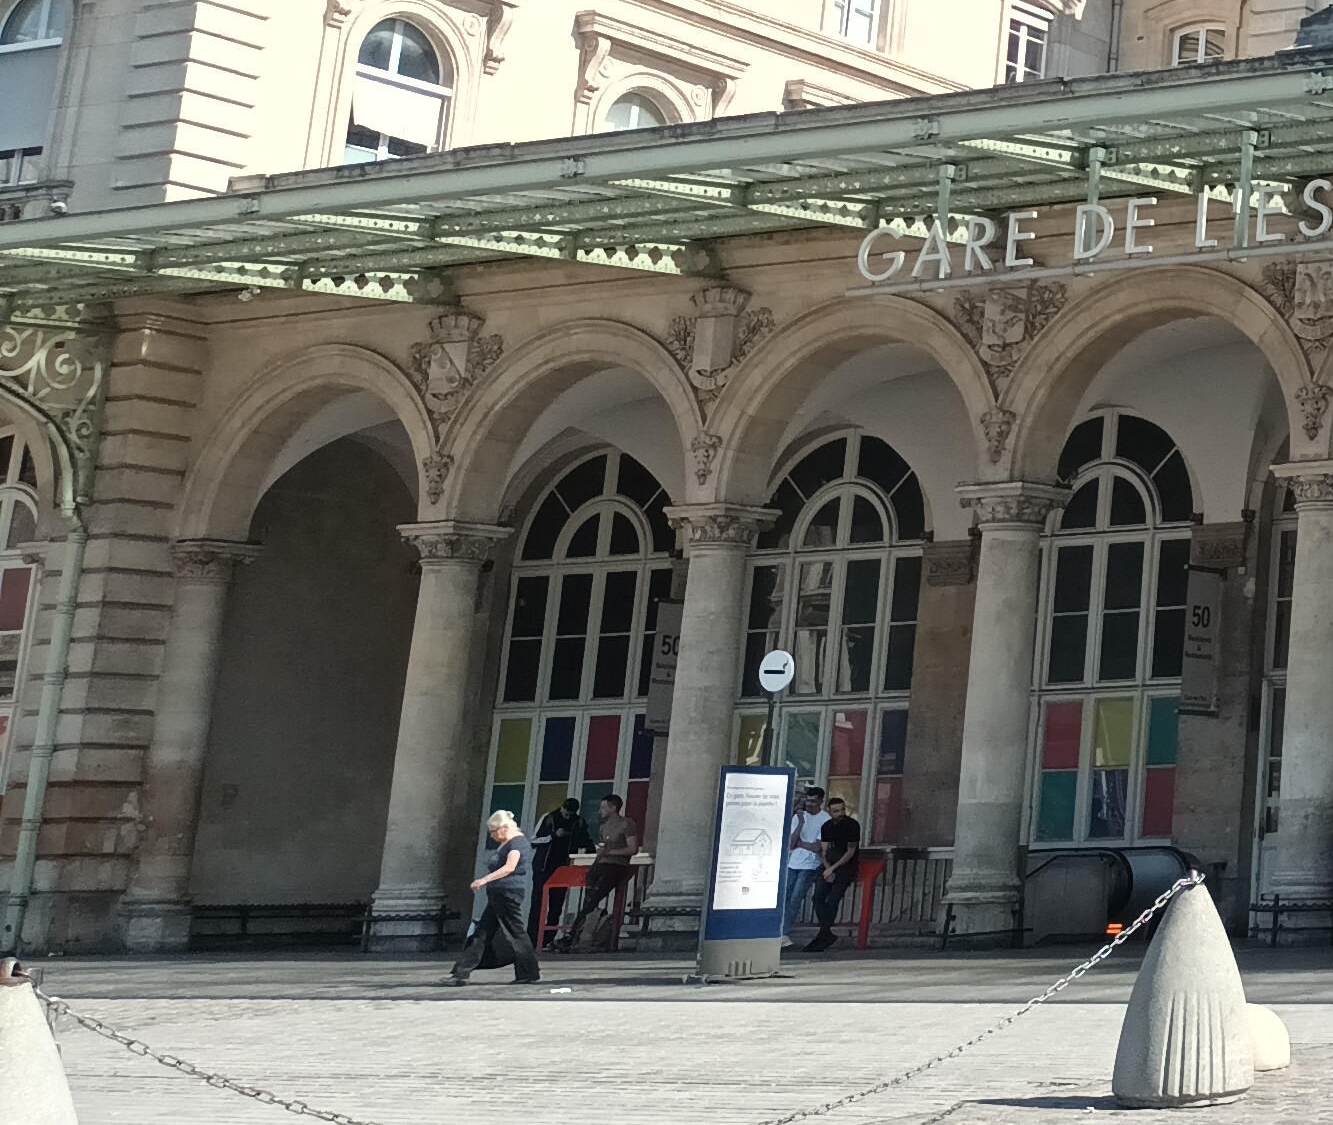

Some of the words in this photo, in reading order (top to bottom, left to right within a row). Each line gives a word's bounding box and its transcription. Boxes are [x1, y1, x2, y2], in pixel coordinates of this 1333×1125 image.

[857, 210, 1039, 283] GARE
[1073, 197, 1158, 261] DE
[1191, 604, 1211, 628] 50
